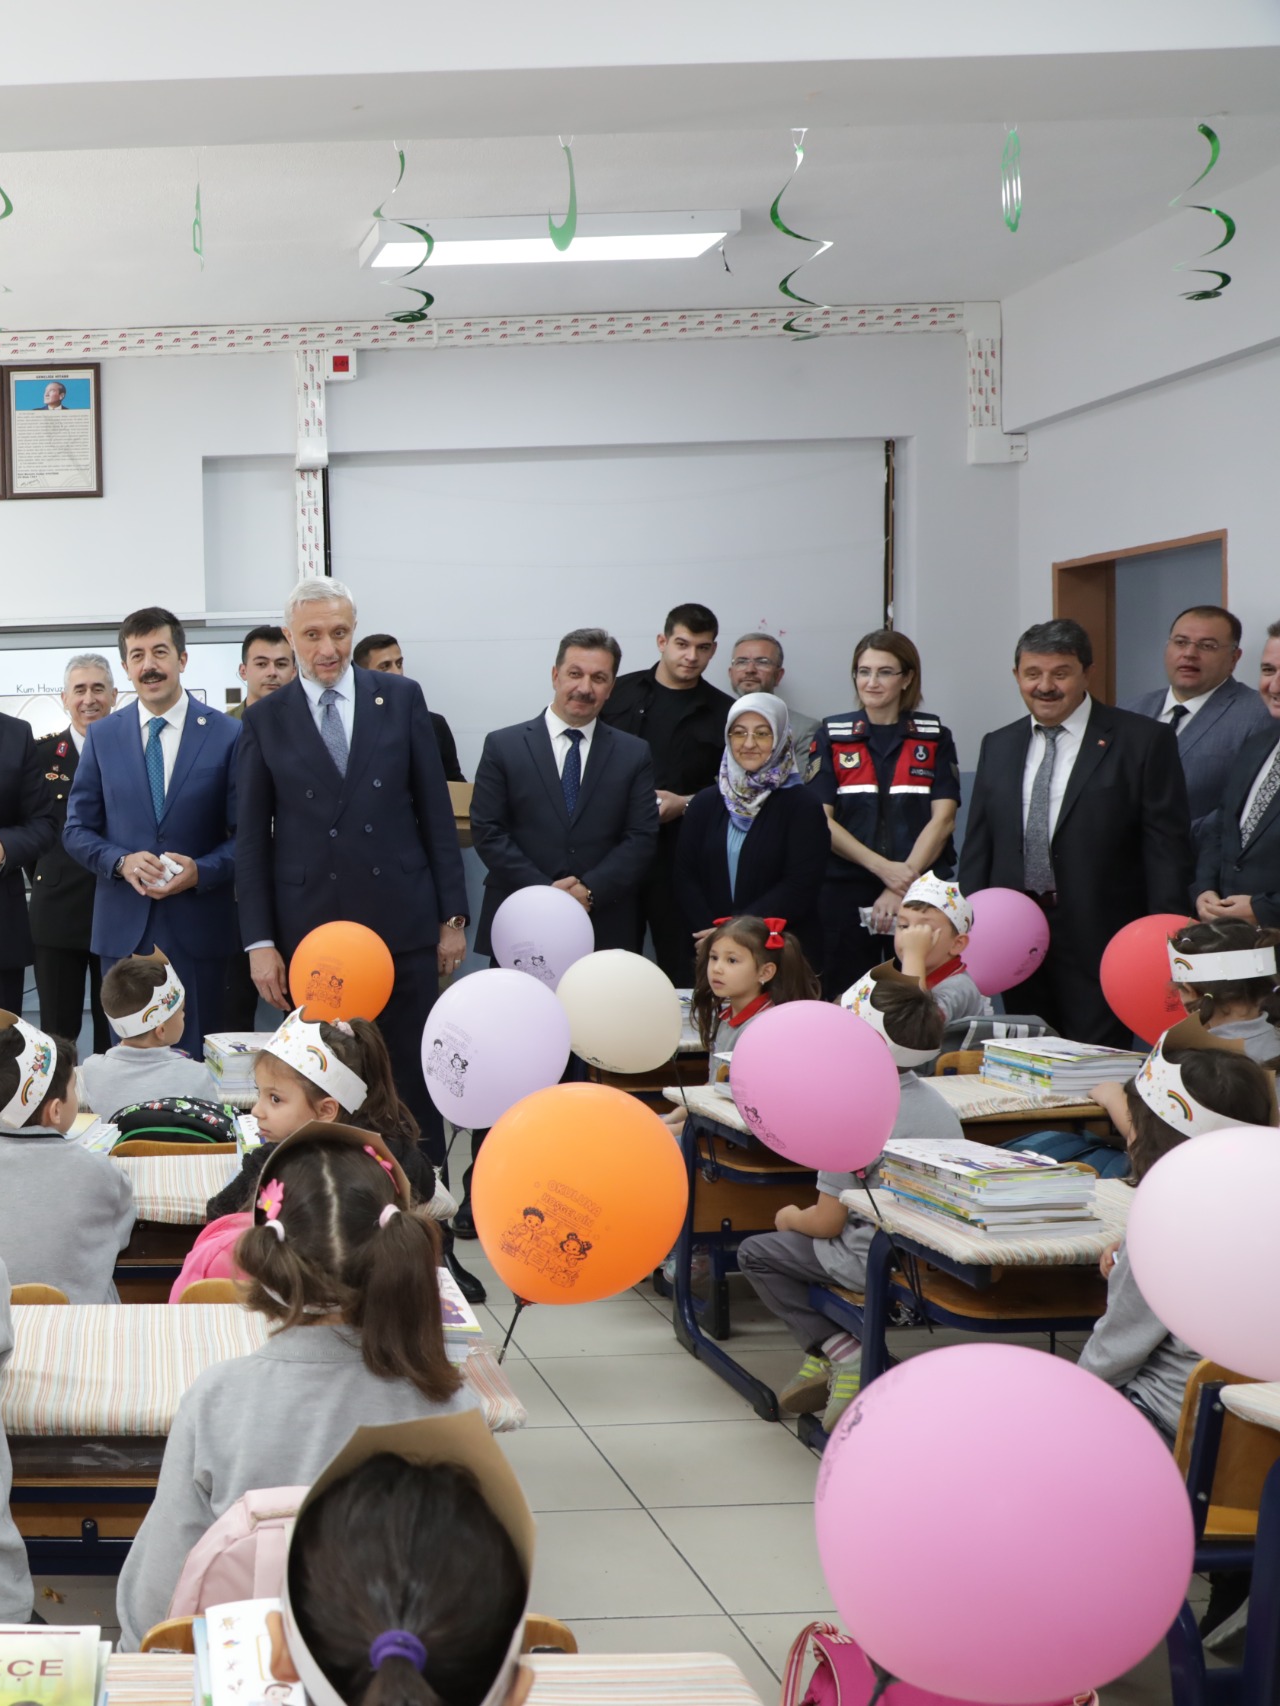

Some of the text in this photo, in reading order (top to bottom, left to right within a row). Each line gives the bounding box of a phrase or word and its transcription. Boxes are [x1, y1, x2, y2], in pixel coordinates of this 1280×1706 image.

[16, 682, 63, 694] Kum Havuz
[547, 1179, 602, 1218] OKULUNA
